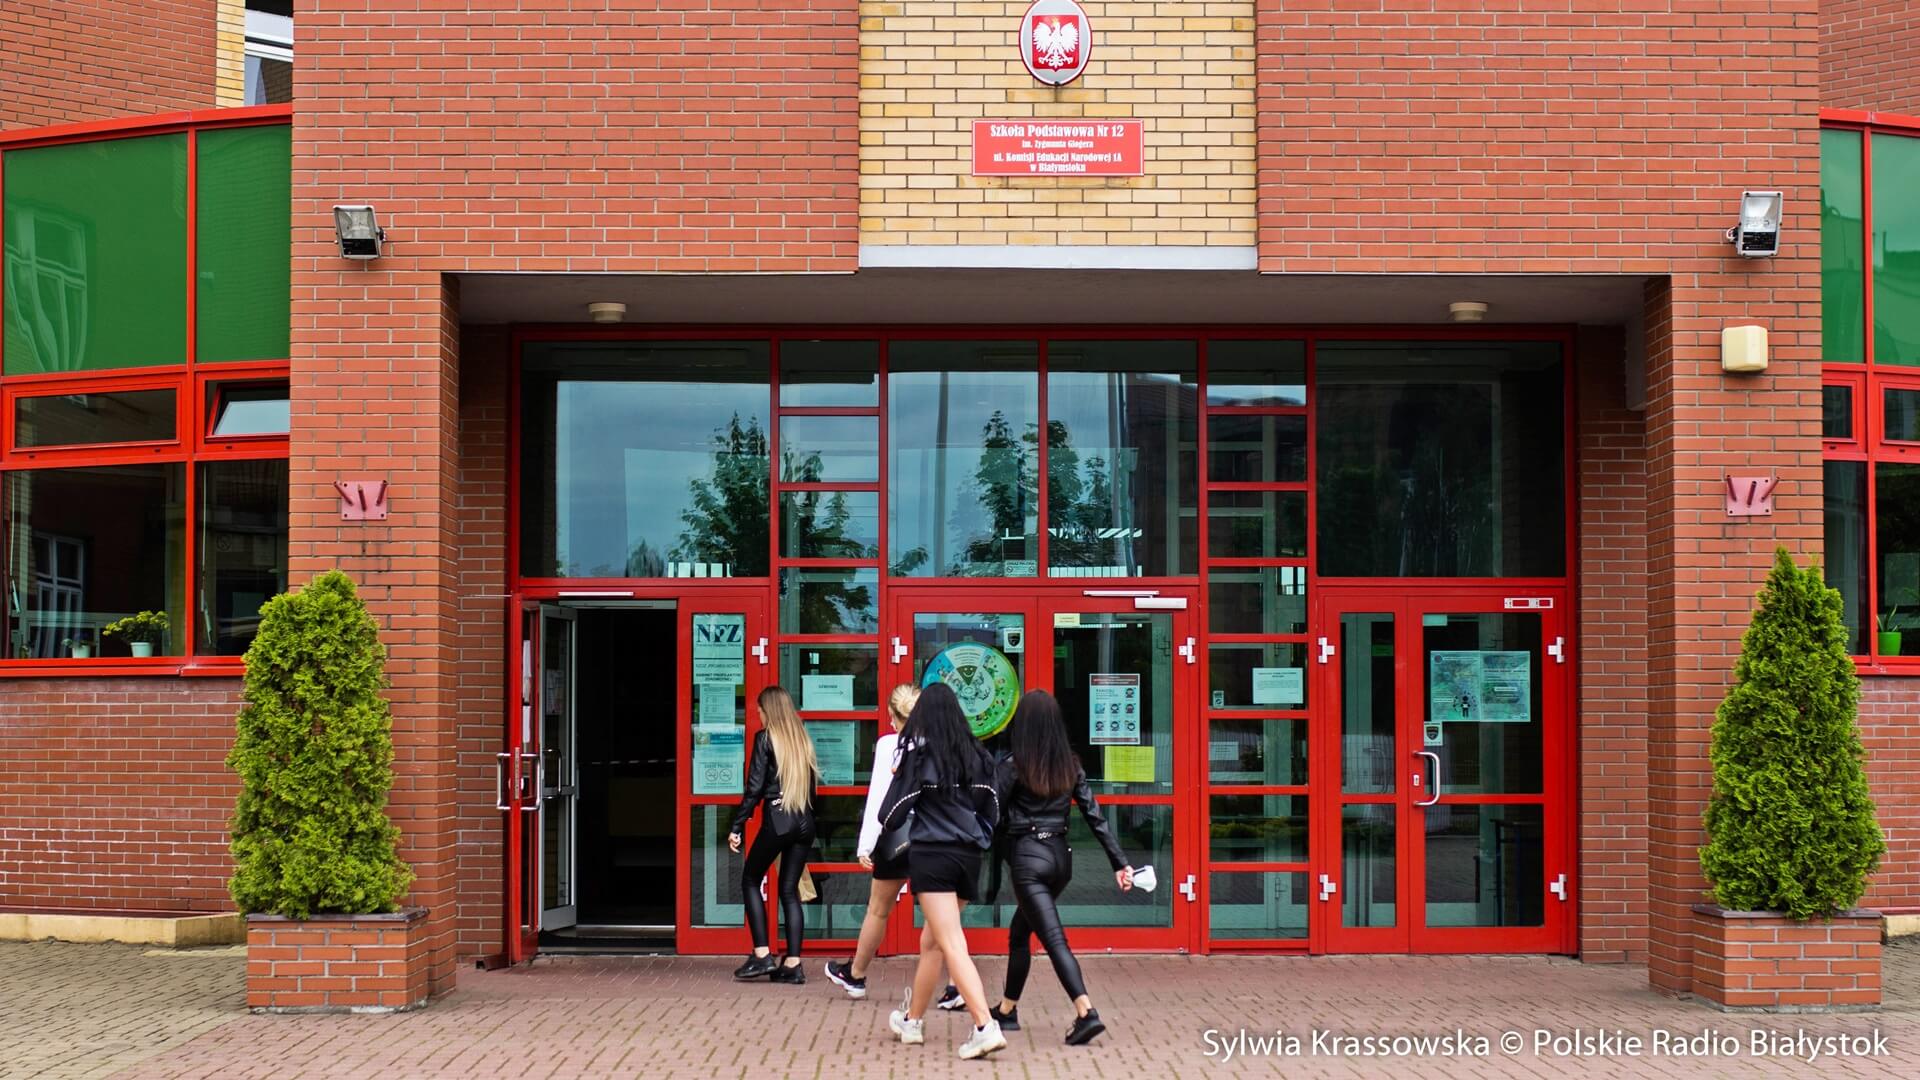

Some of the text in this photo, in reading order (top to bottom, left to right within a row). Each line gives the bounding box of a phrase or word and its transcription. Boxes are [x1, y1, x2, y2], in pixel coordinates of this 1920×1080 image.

[990, 124, 1124, 138] Szkoła Podstawowa Nr 12
[1034, 139, 1066, 149] Zygmunta
[993, 152, 1122, 164] ul. Komisji Edukacji Narodowej 1A
[1030, 163, 1086, 173] w Białymstoku
[696, 624, 742, 643] NFZ
